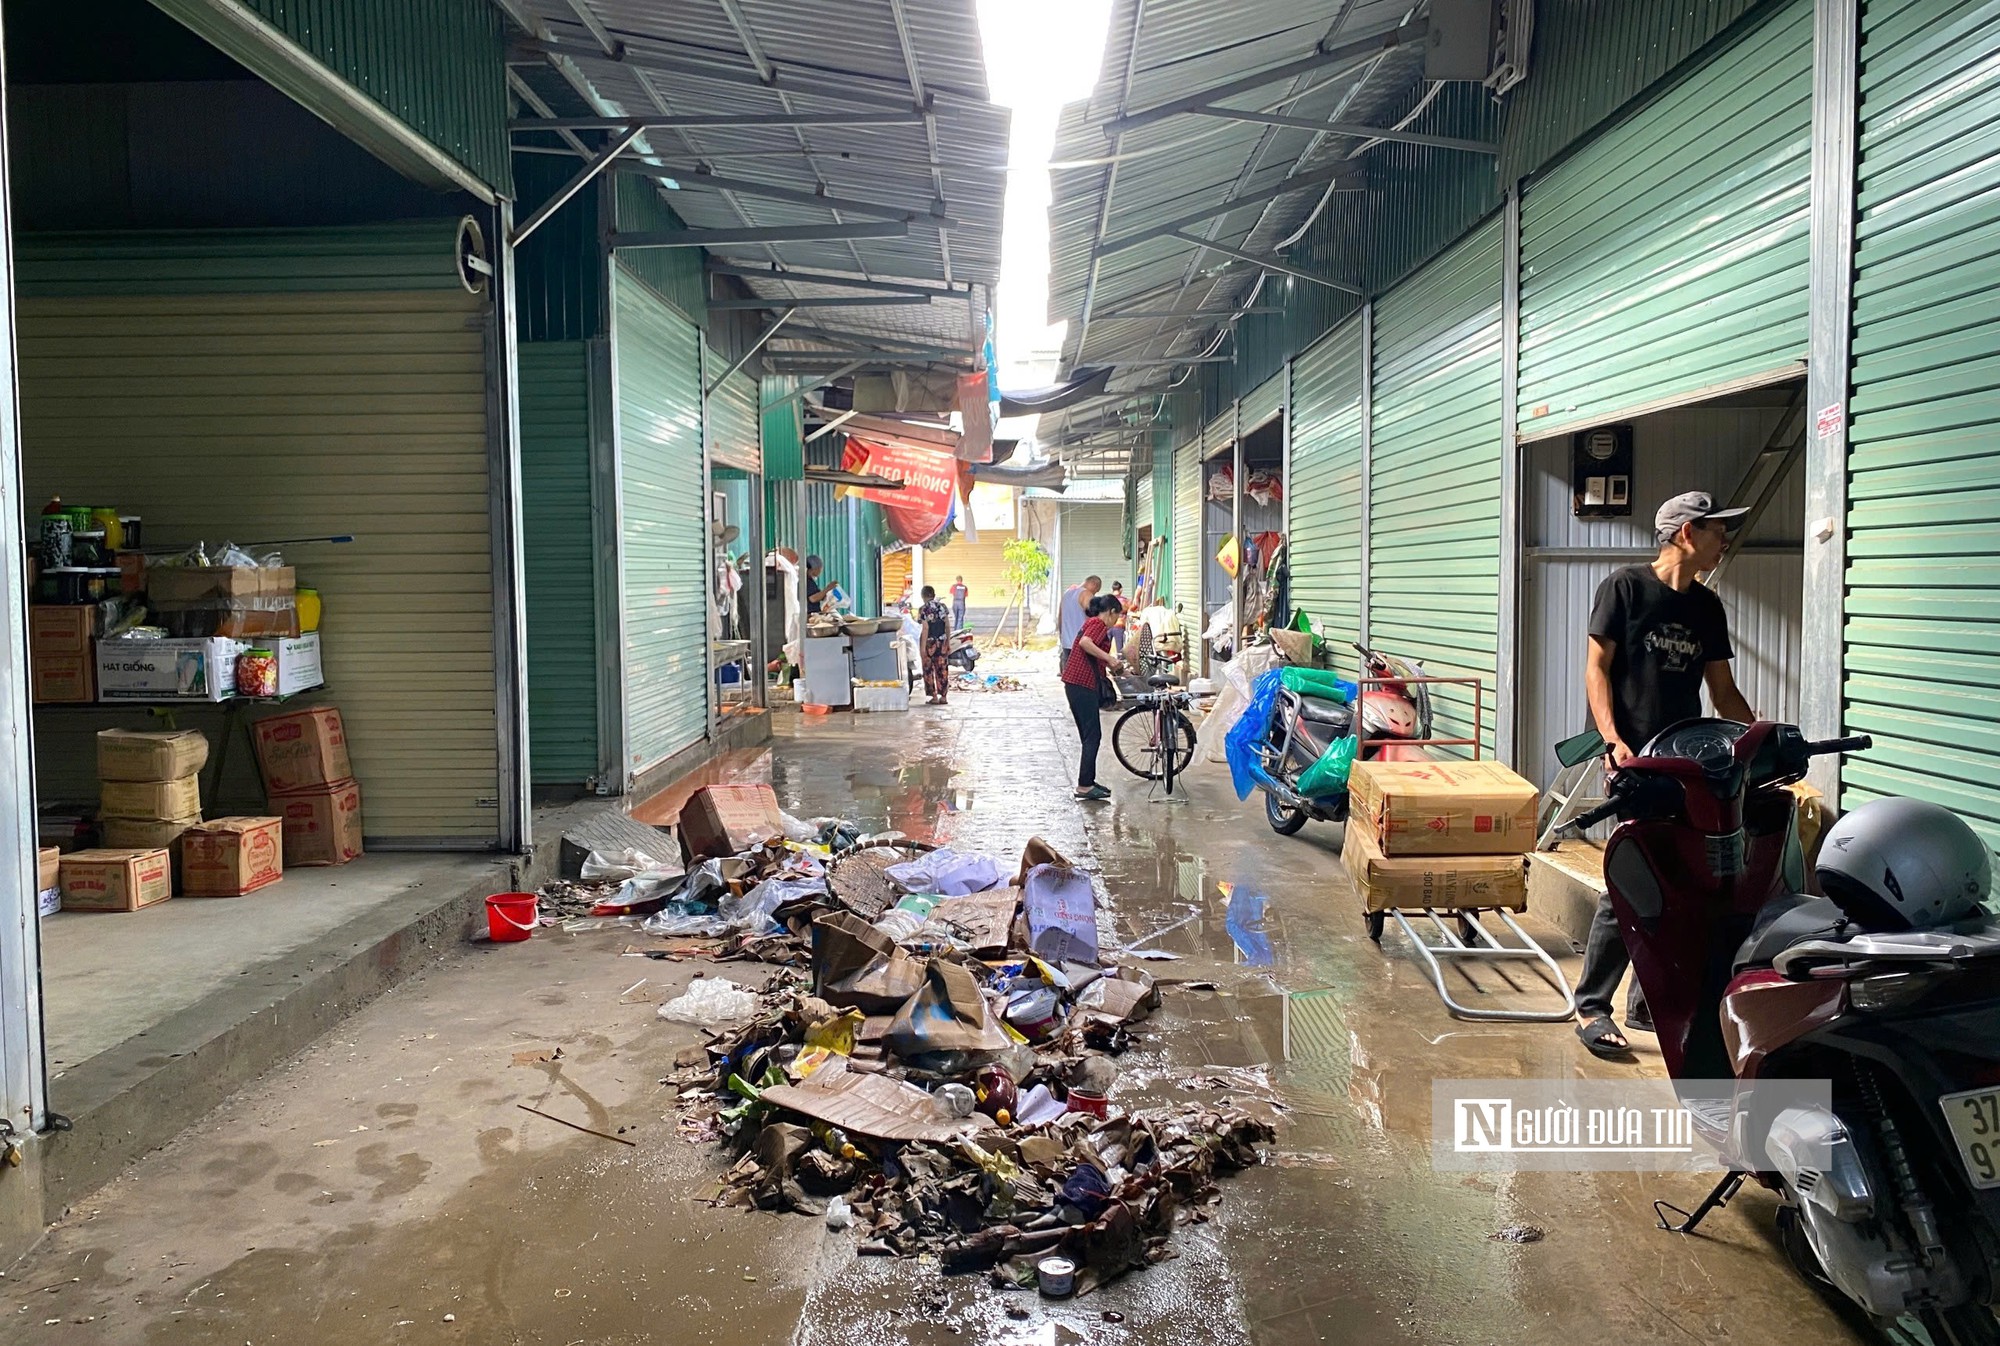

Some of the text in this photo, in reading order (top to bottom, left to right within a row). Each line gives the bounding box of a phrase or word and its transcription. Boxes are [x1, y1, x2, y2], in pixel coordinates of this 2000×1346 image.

[122, 659, 155, 671] GIỐNG
[1423, 871, 1433, 887] 500
[1963, 1095, 2000, 1135] 37
